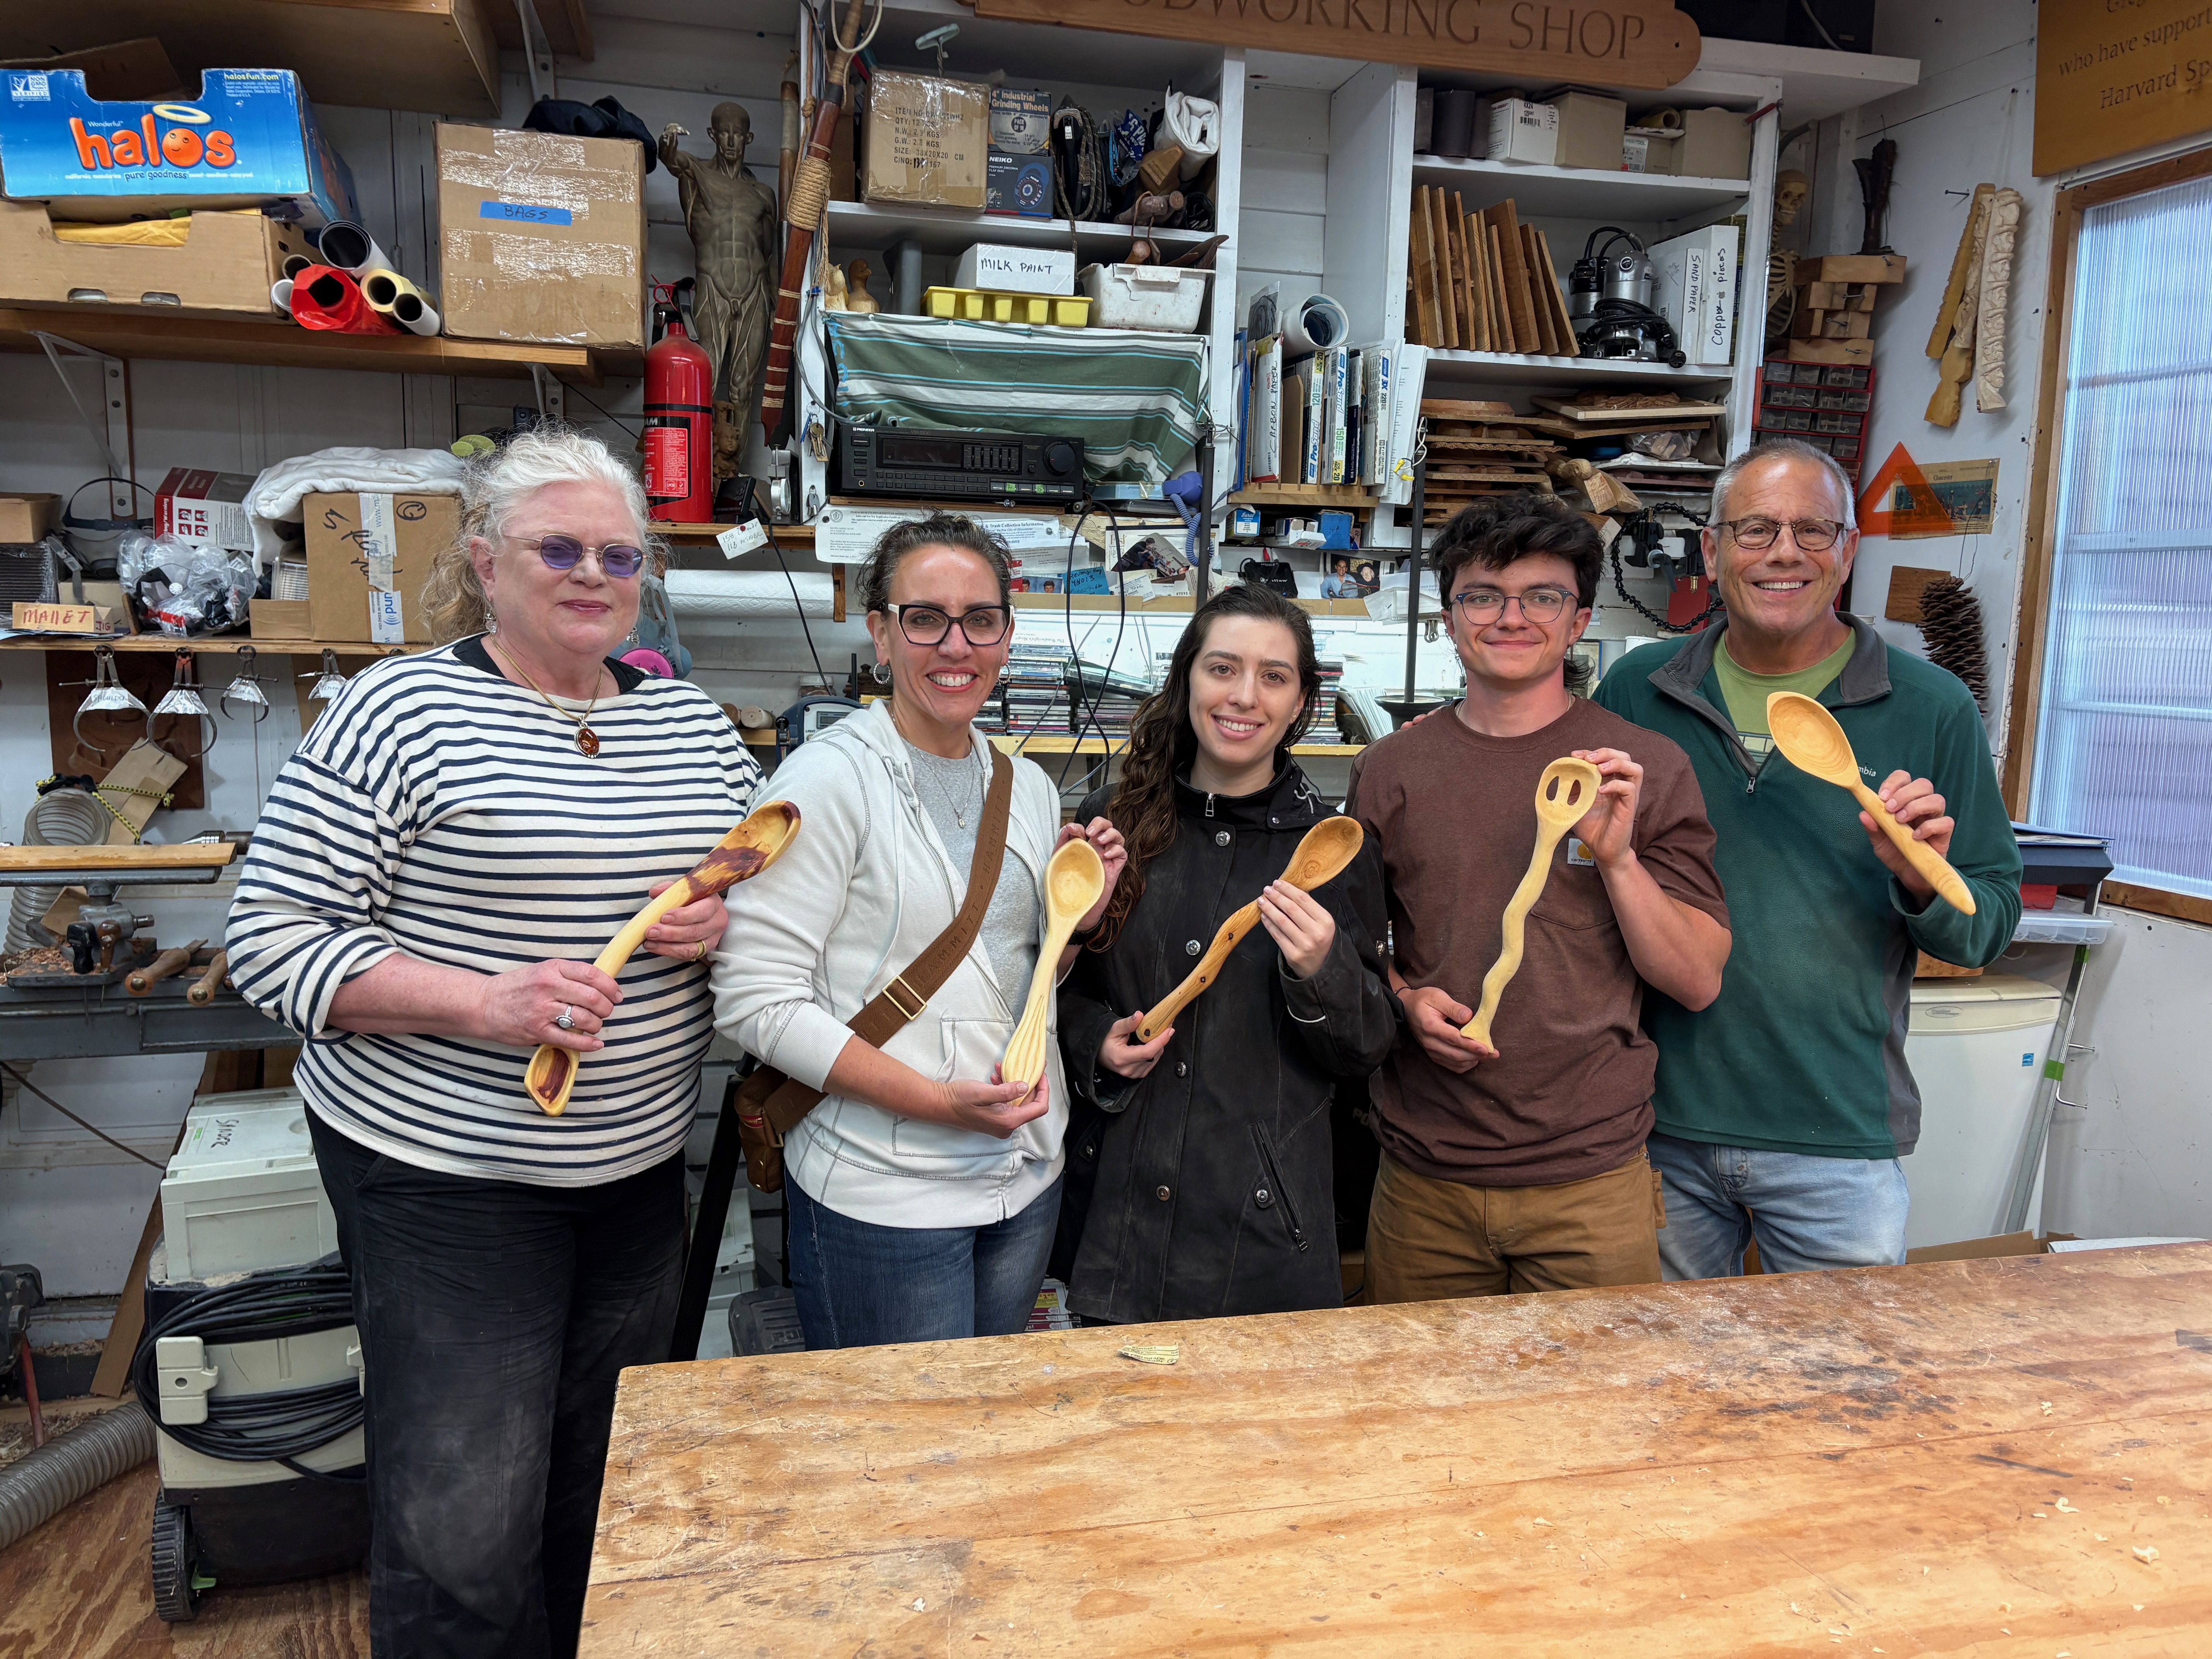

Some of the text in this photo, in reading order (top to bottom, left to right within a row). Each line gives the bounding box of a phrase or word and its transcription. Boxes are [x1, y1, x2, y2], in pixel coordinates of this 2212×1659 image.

[1510, 2, 1644, 59] SHOP
[2059, 53, 2093, 76] who
[2099, 37, 2138, 62] have
[223, 71, 279, 81] halosfun.com
[2100, 64, 2177, 109] Harvard
[1001, 90, 1035, 102] Industrial
[895, 107, 912, 115] ITEM
[991, 98, 1049, 112] Grinding Wheels
[69, 113, 236, 168] halos
[894, 146, 911, 155] SIZE:
[125, 169, 188, 182] pure goodness
[503, 204, 548, 220] BAGS
[981, 258, 1054, 275] MILK PAINT
[1688, 255, 1701, 313] SAND PAPER
[1317, 352, 1324, 361] 20
[1336, 369, 1345, 414] ProSand
[1381, 378, 1388, 391] 3X
[1312, 393, 1321, 407] 120
[1310, 419, 1319, 462] ProSand
[1336, 426, 1344, 441] 150
[1333, 473, 1340, 481] 20
[1260, 526, 1274, 535] PAPER
[722, 533, 734, 543] 158
[95, 620, 111, 631] JIG
[982, 794, 1005, 874] HAMMITT
